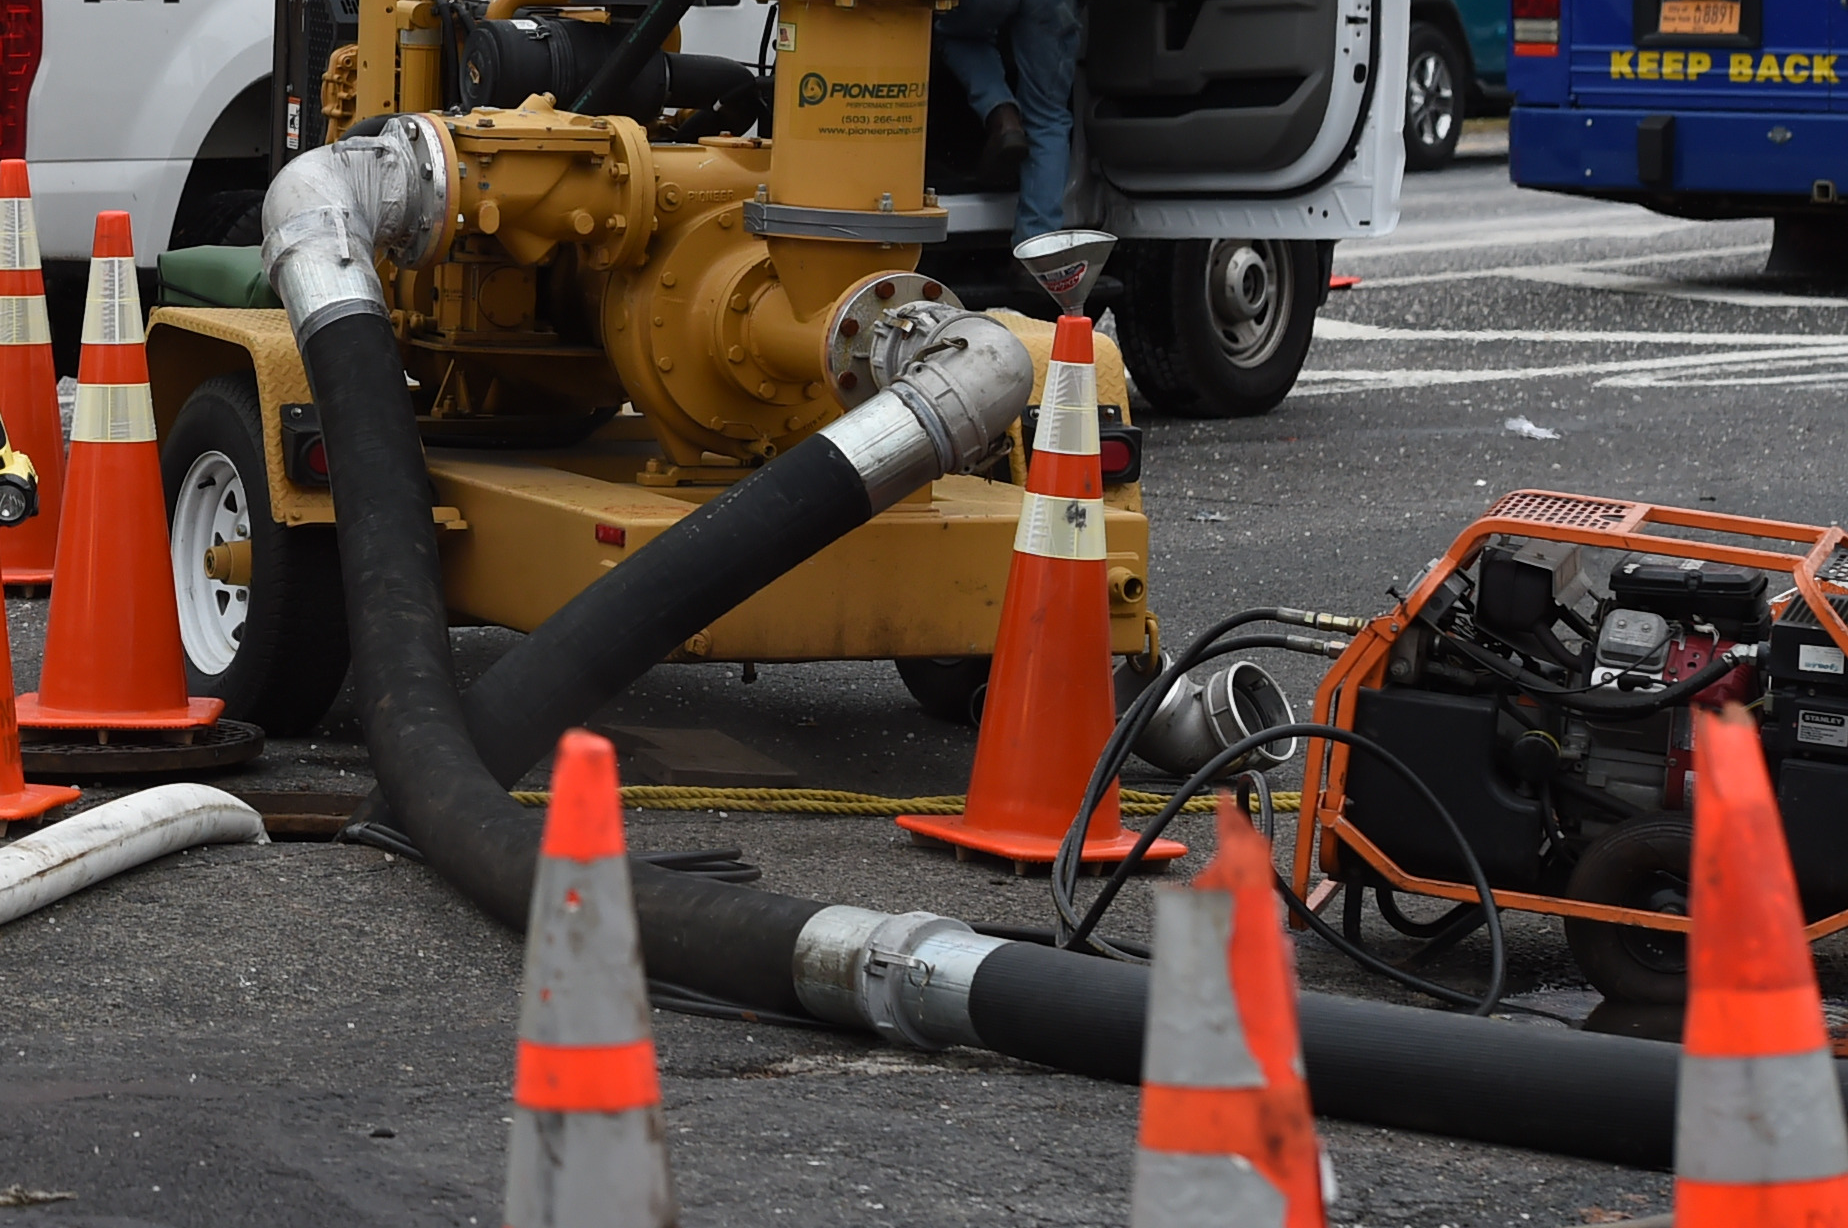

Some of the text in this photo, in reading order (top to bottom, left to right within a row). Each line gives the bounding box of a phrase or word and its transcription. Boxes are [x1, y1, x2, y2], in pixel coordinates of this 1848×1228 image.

[1611, 51, 1839, 83] KEEP BACK
[841, 115, 870, 125] (503)
[1804, 715, 1842, 726] STANLEY
